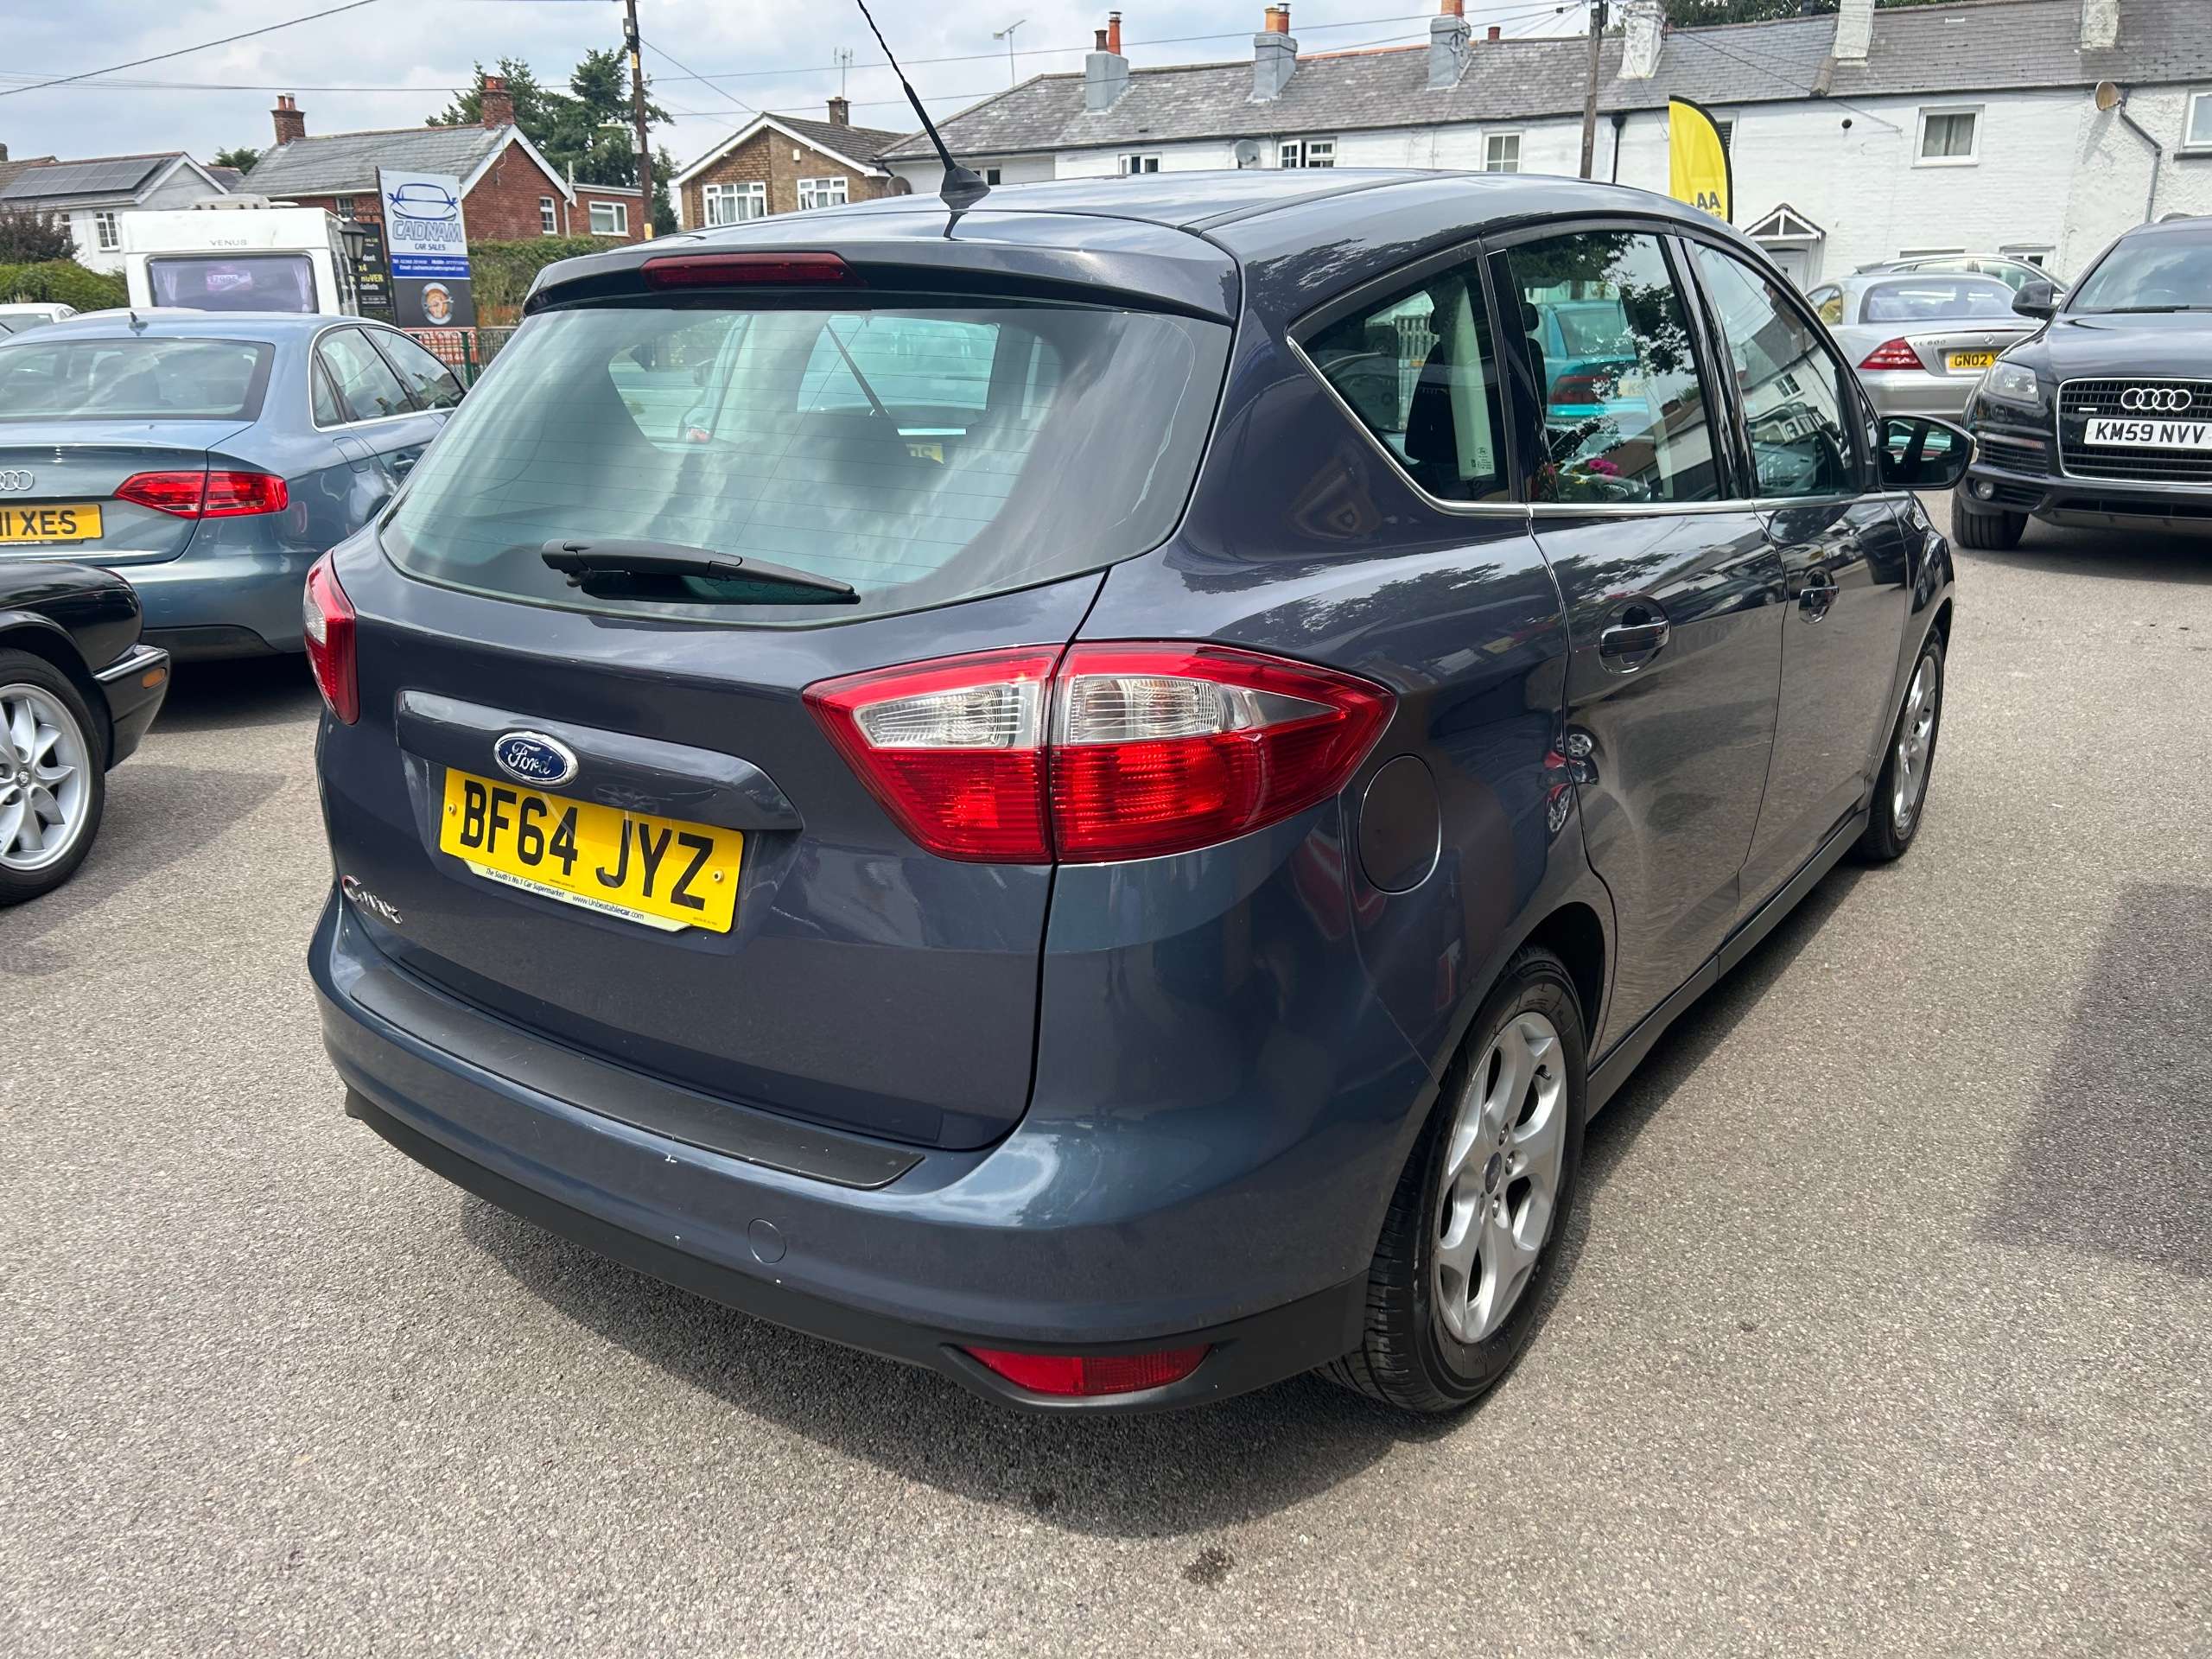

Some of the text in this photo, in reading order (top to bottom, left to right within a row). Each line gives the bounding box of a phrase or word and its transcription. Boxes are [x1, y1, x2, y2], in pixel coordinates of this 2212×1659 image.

[392, 219, 463, 243] CADNAM
[1954, 353, 1988, 367] GN02
[2094, 422, 2206, 444] KM59 NVV
[20, 510, 77, 536] XES
[507, 741, 553, 775] Ford
[460, 779, 715, 912] BF64 JYZ
[486, 868, 494, 876] The
[494, 871, 512, 882] South's
[524, 880, 533, 889] Car
[533, 882, 565, 898] Supermarket
[572, 894, 645, 920] www.Unbeatablecar.com
